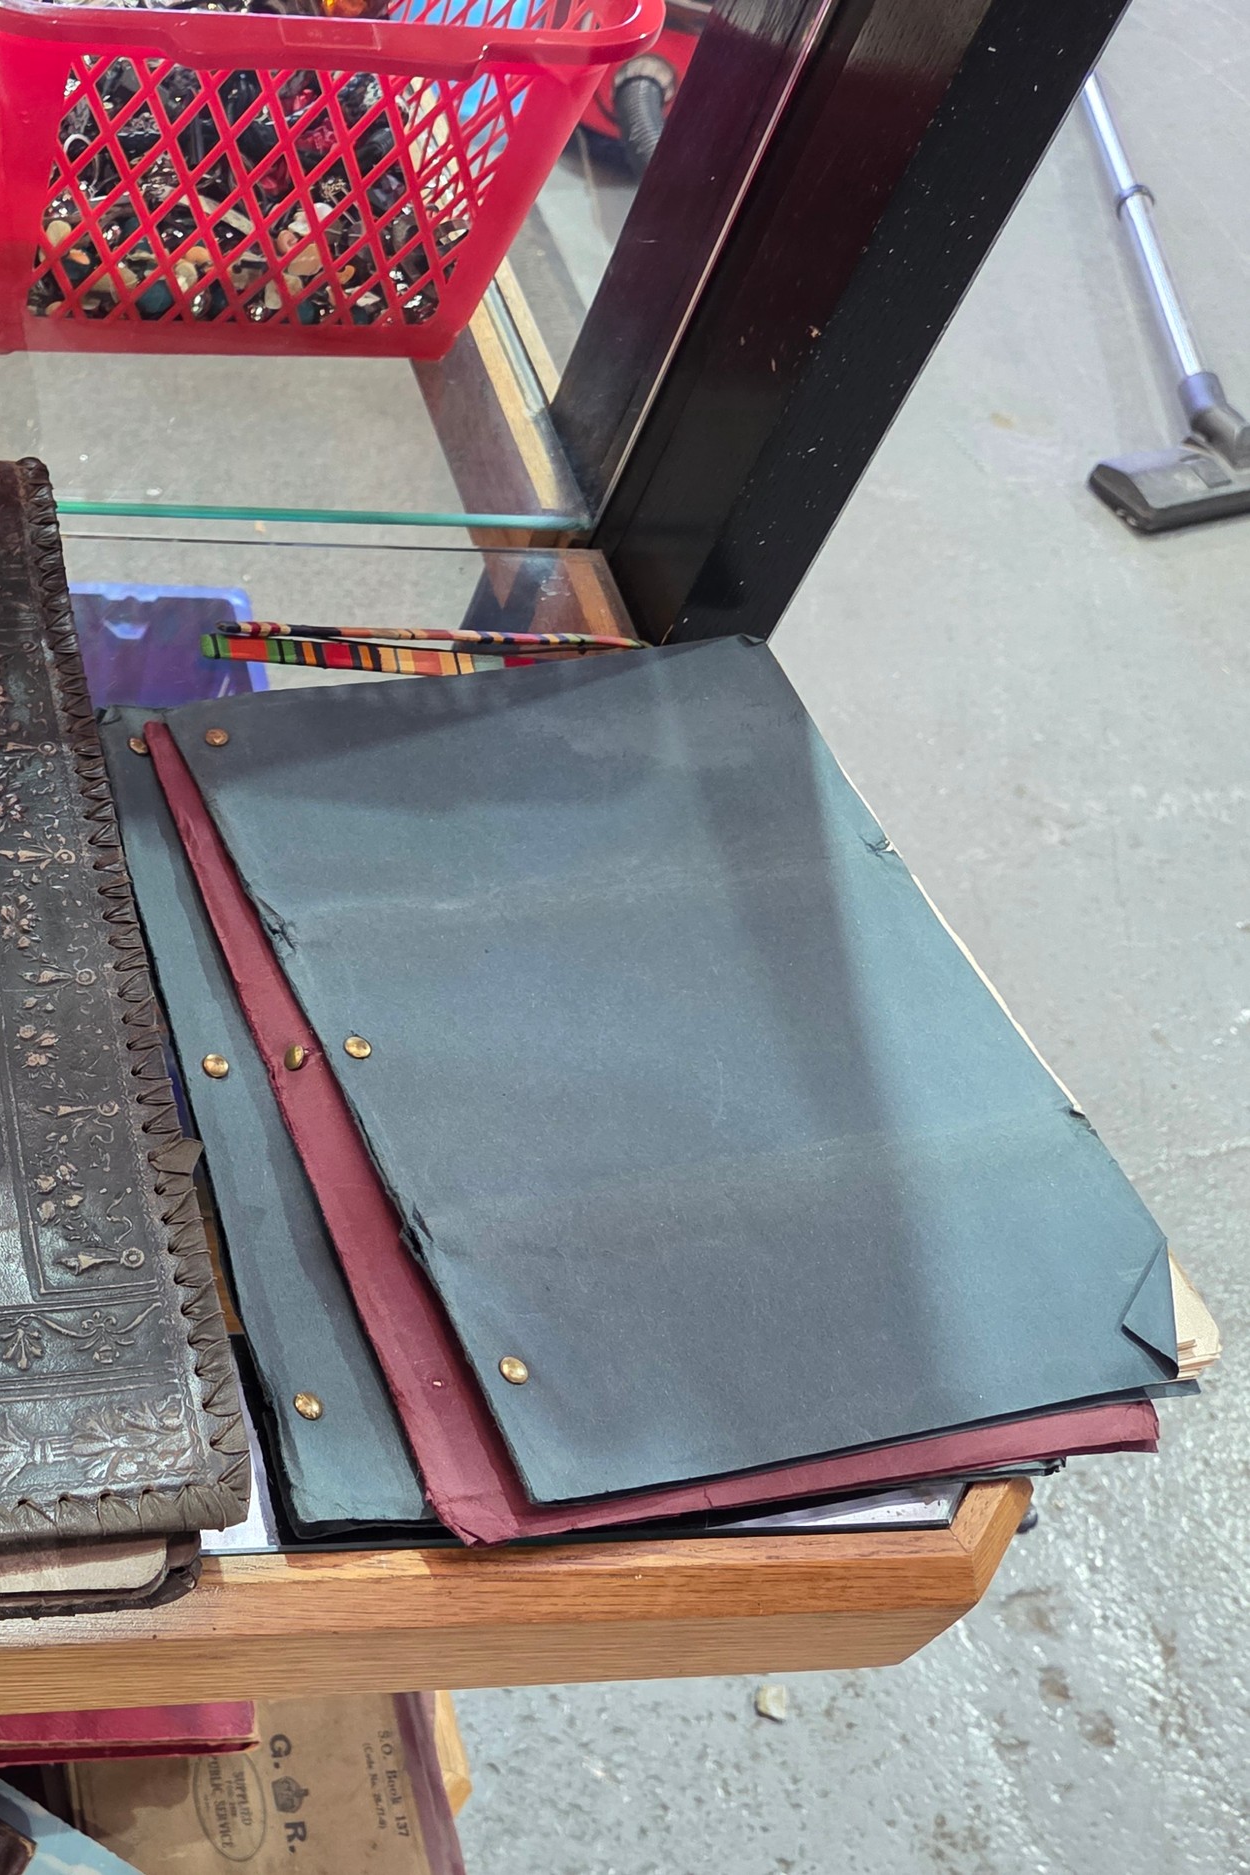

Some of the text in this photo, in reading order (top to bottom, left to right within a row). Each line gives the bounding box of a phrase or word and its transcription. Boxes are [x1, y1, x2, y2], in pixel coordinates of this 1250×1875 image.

[215, 1800, 234, 1848] SERVICE
[385, 1769, 403, 1805] Book
[395, 1816, 410, 1837] 137
